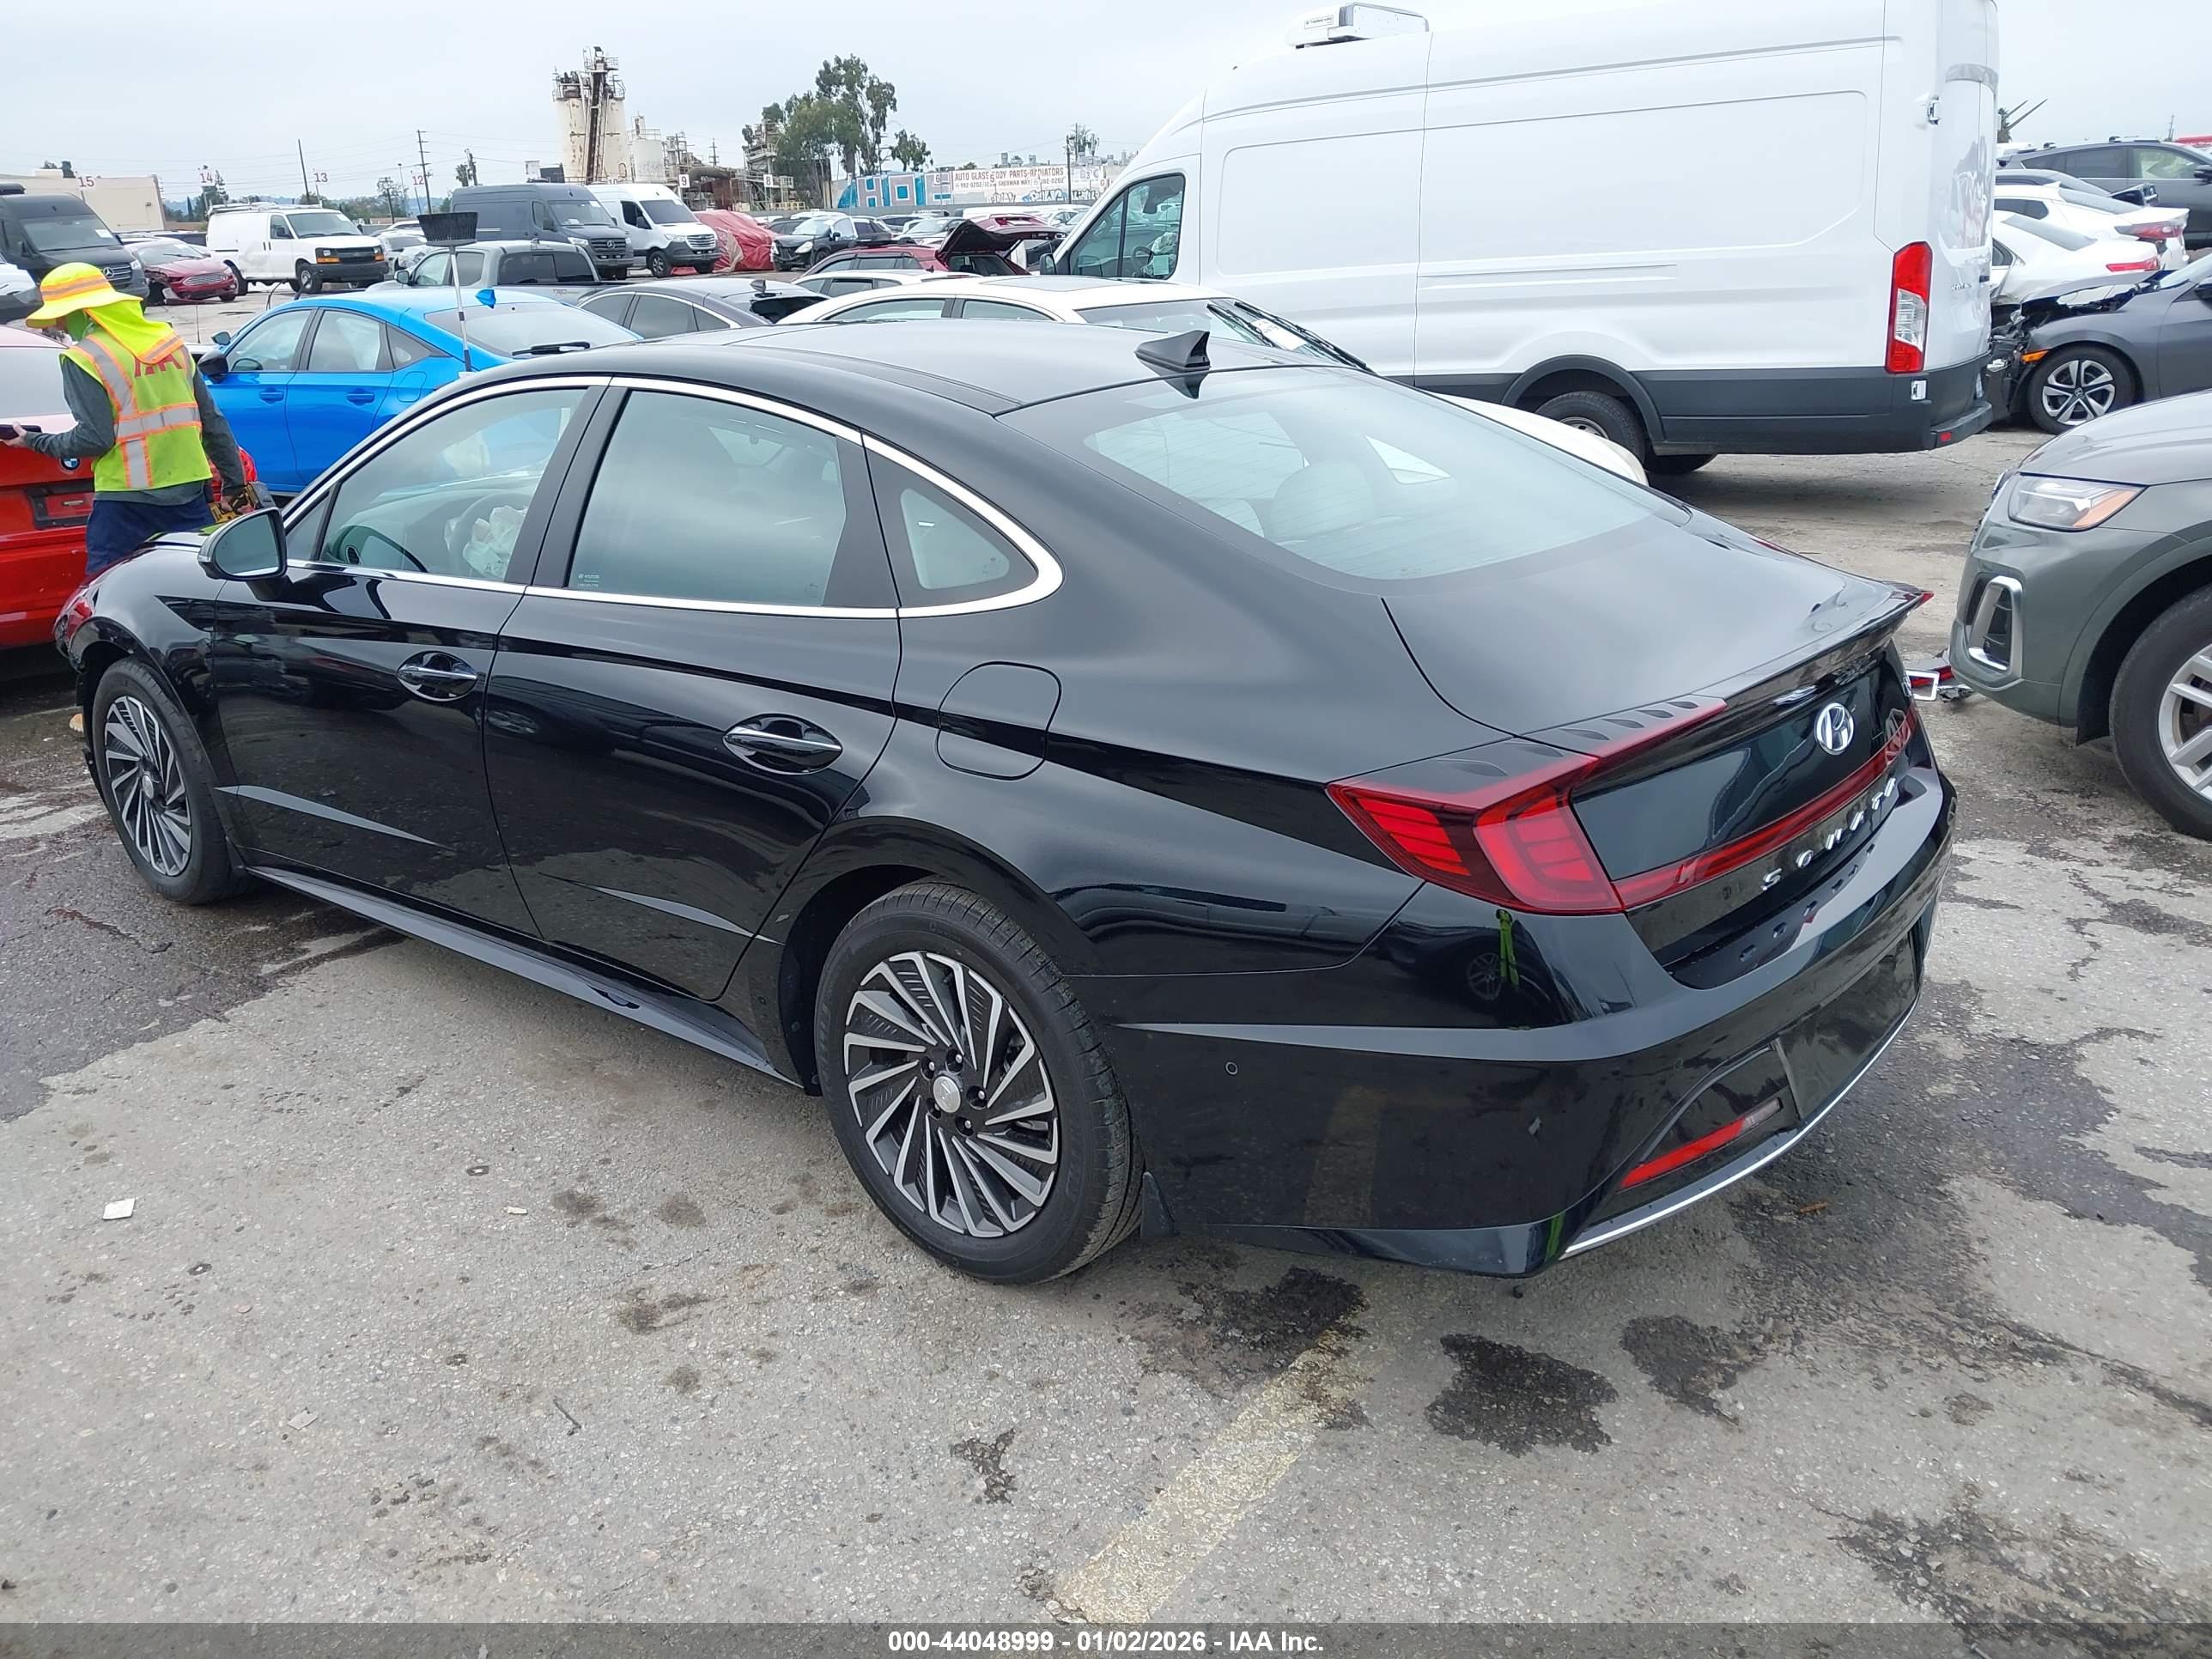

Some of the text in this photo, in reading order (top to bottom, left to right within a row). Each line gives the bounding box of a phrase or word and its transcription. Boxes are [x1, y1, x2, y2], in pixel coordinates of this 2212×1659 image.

[200, 173, 214, 183] 14
[314, 173, 328, 183] 13
[413, 175, 424, 185] 12
[681, 175, 687, 186] 9
[971, 171, 989, 180] GLASS
[989, 173, 995, 183] 5
[78, 176, 95, 188] 15
